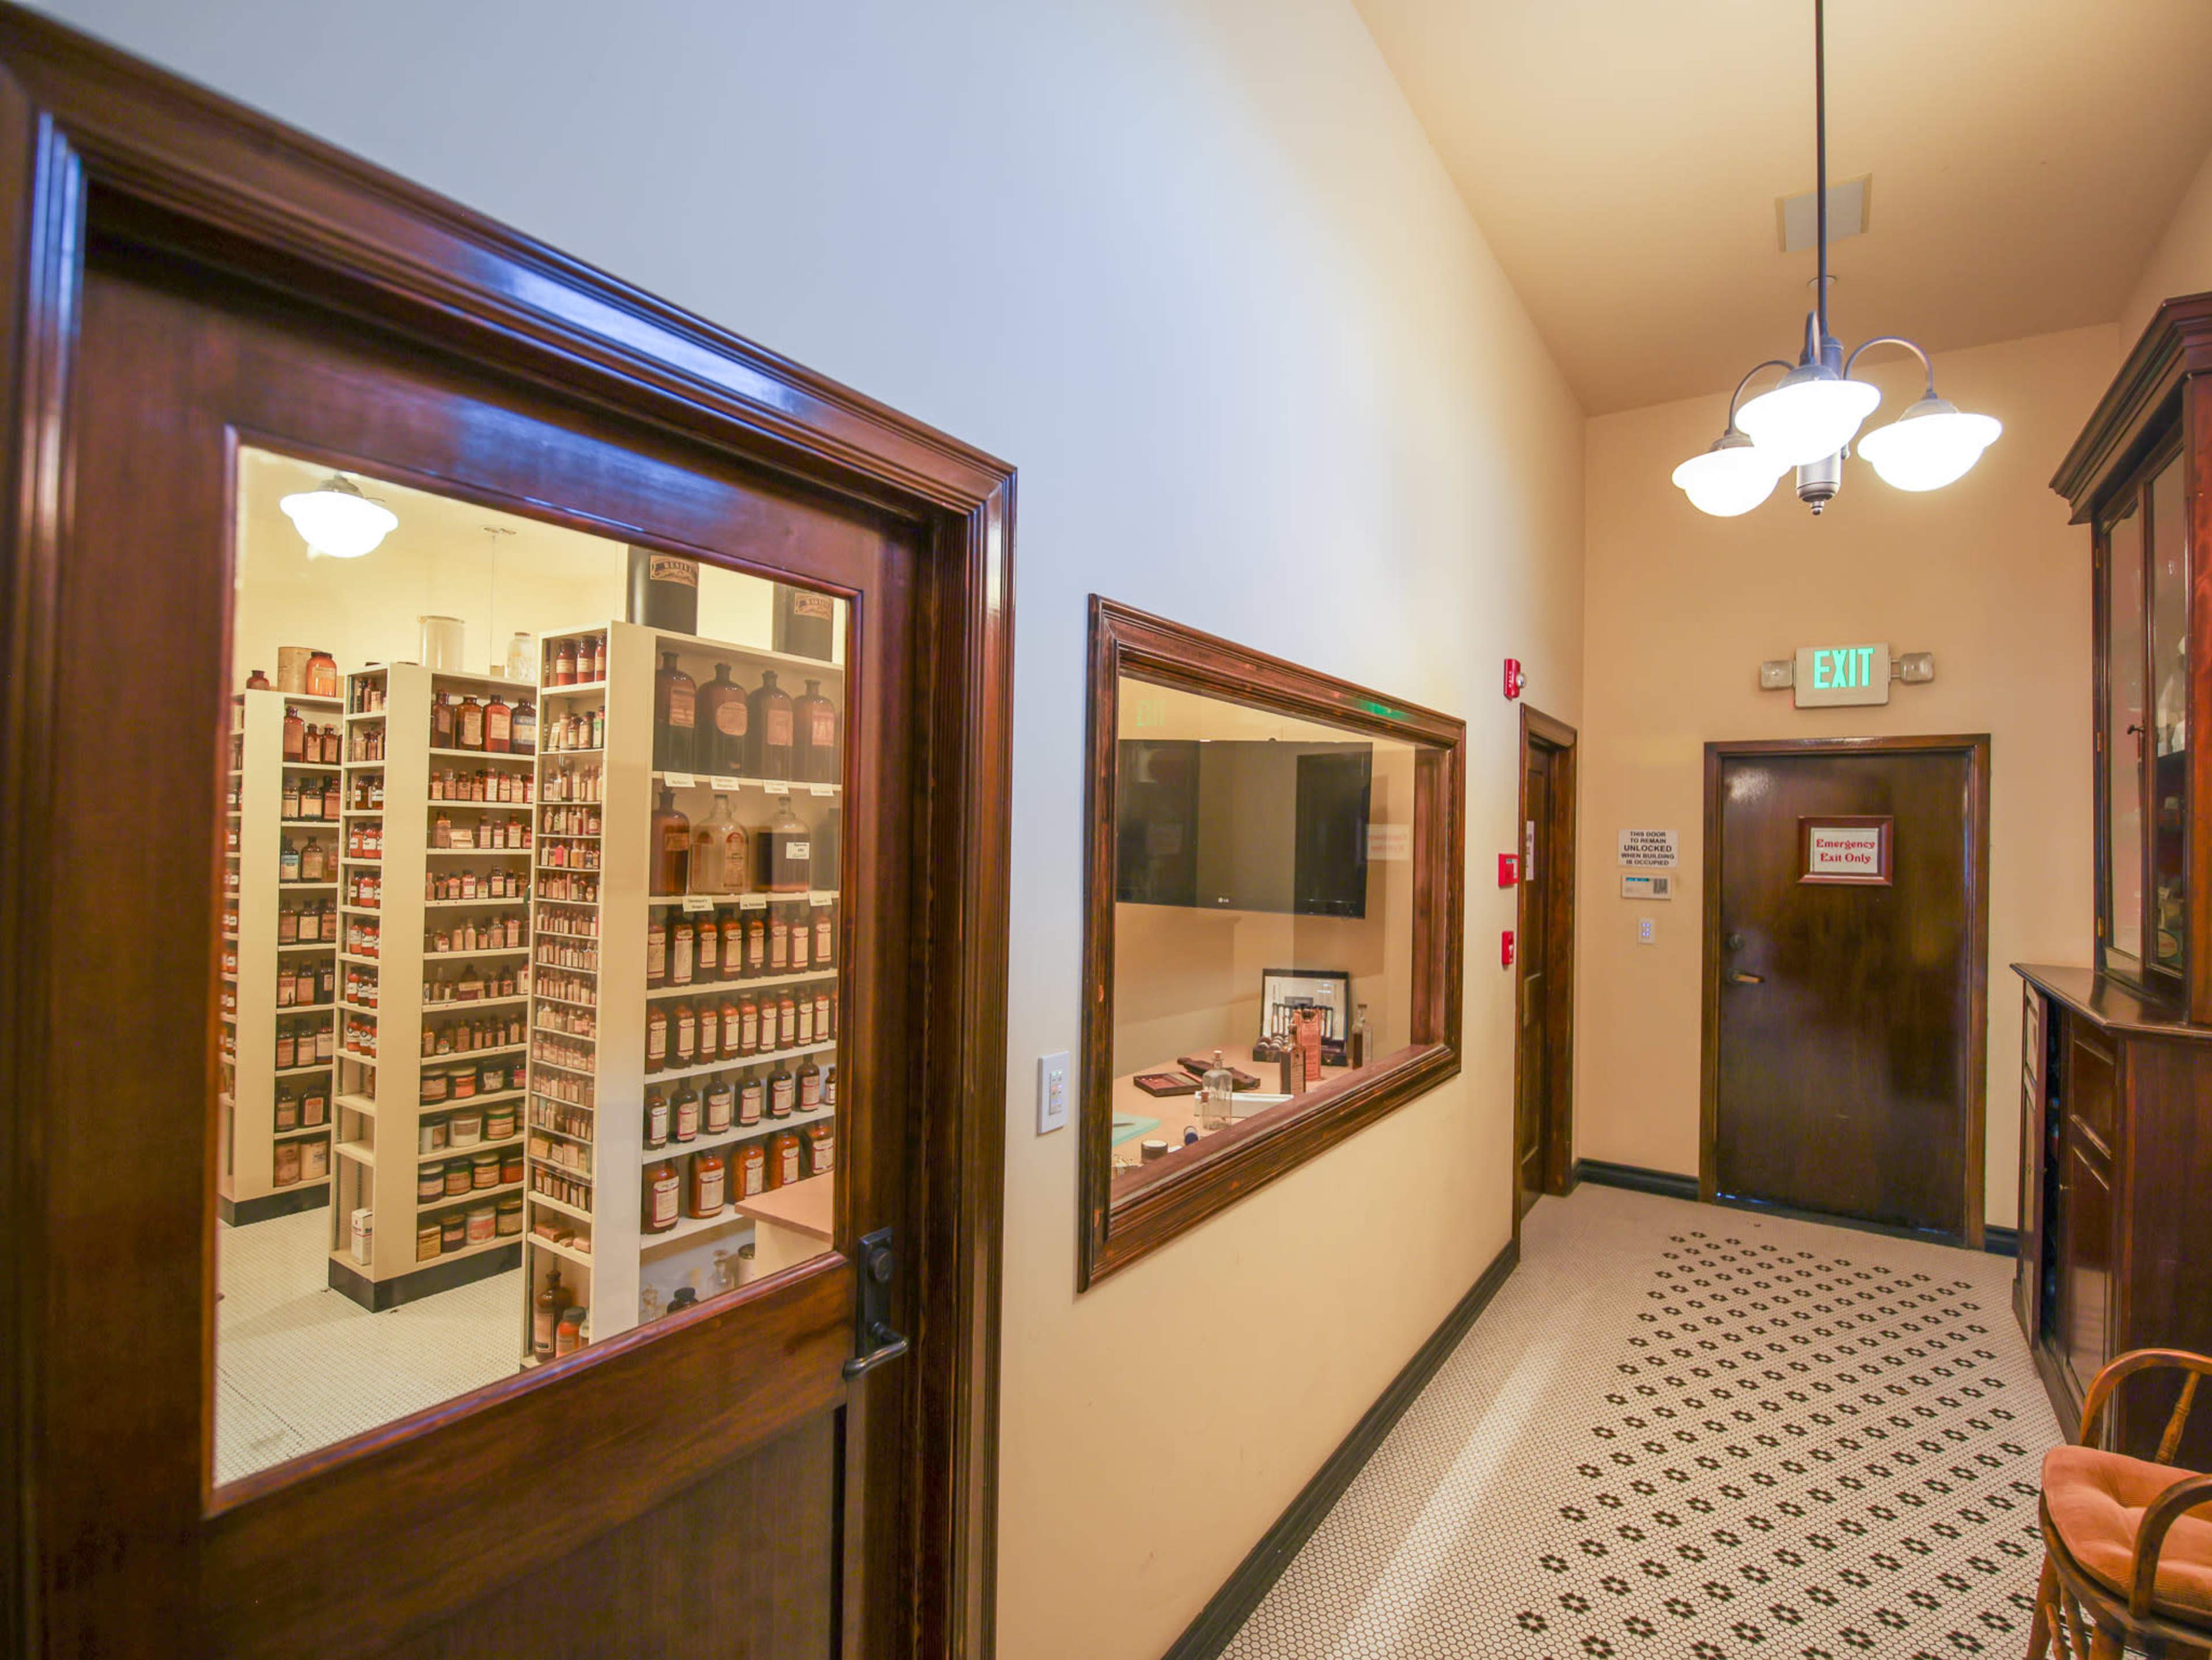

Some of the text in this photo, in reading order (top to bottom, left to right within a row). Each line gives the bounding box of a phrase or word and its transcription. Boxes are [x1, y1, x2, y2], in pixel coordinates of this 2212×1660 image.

[1814, 647, 1874, 689] EXIT
[1816, 839, 1875, 850] Emergency
[1820, 852, 1871, 864] Exit Only
